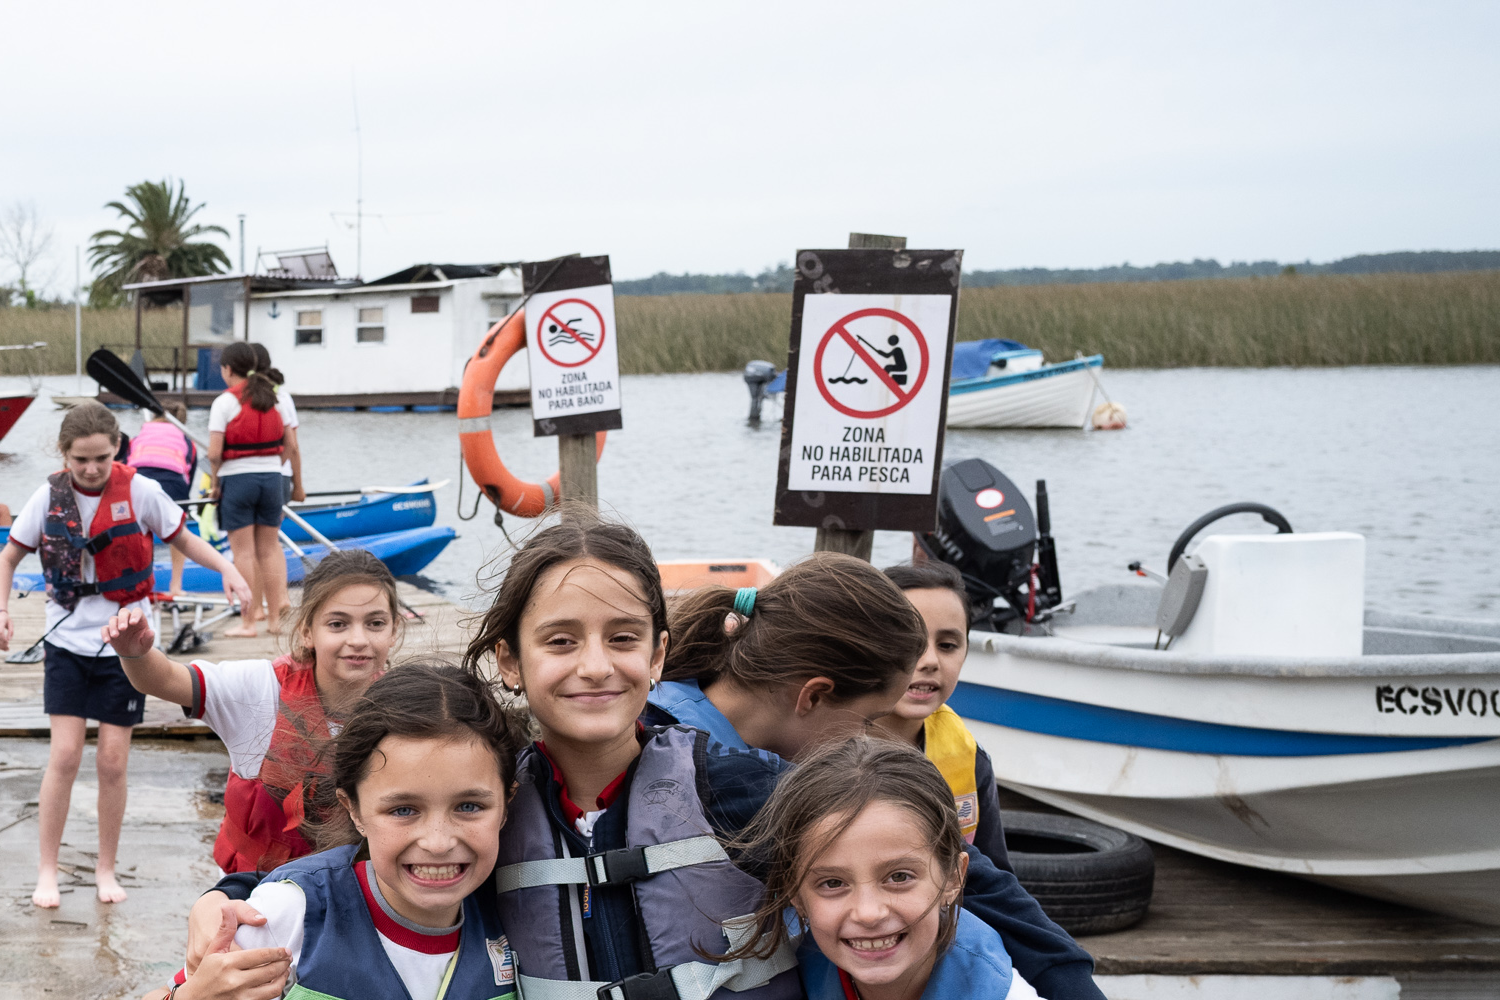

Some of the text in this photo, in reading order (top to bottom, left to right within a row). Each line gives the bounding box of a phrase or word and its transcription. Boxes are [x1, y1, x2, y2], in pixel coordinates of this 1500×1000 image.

[561, 372, 587, 384] ZONA
[538, 381, 612, 399] NO HABILITADA
[548, 398, 574, 410] PARA
[842, 427, 885, 443] ZONA
[802, 445, 923, 464] NO HABILITADA
[811, 465, 910, 483] PARA PESCA
